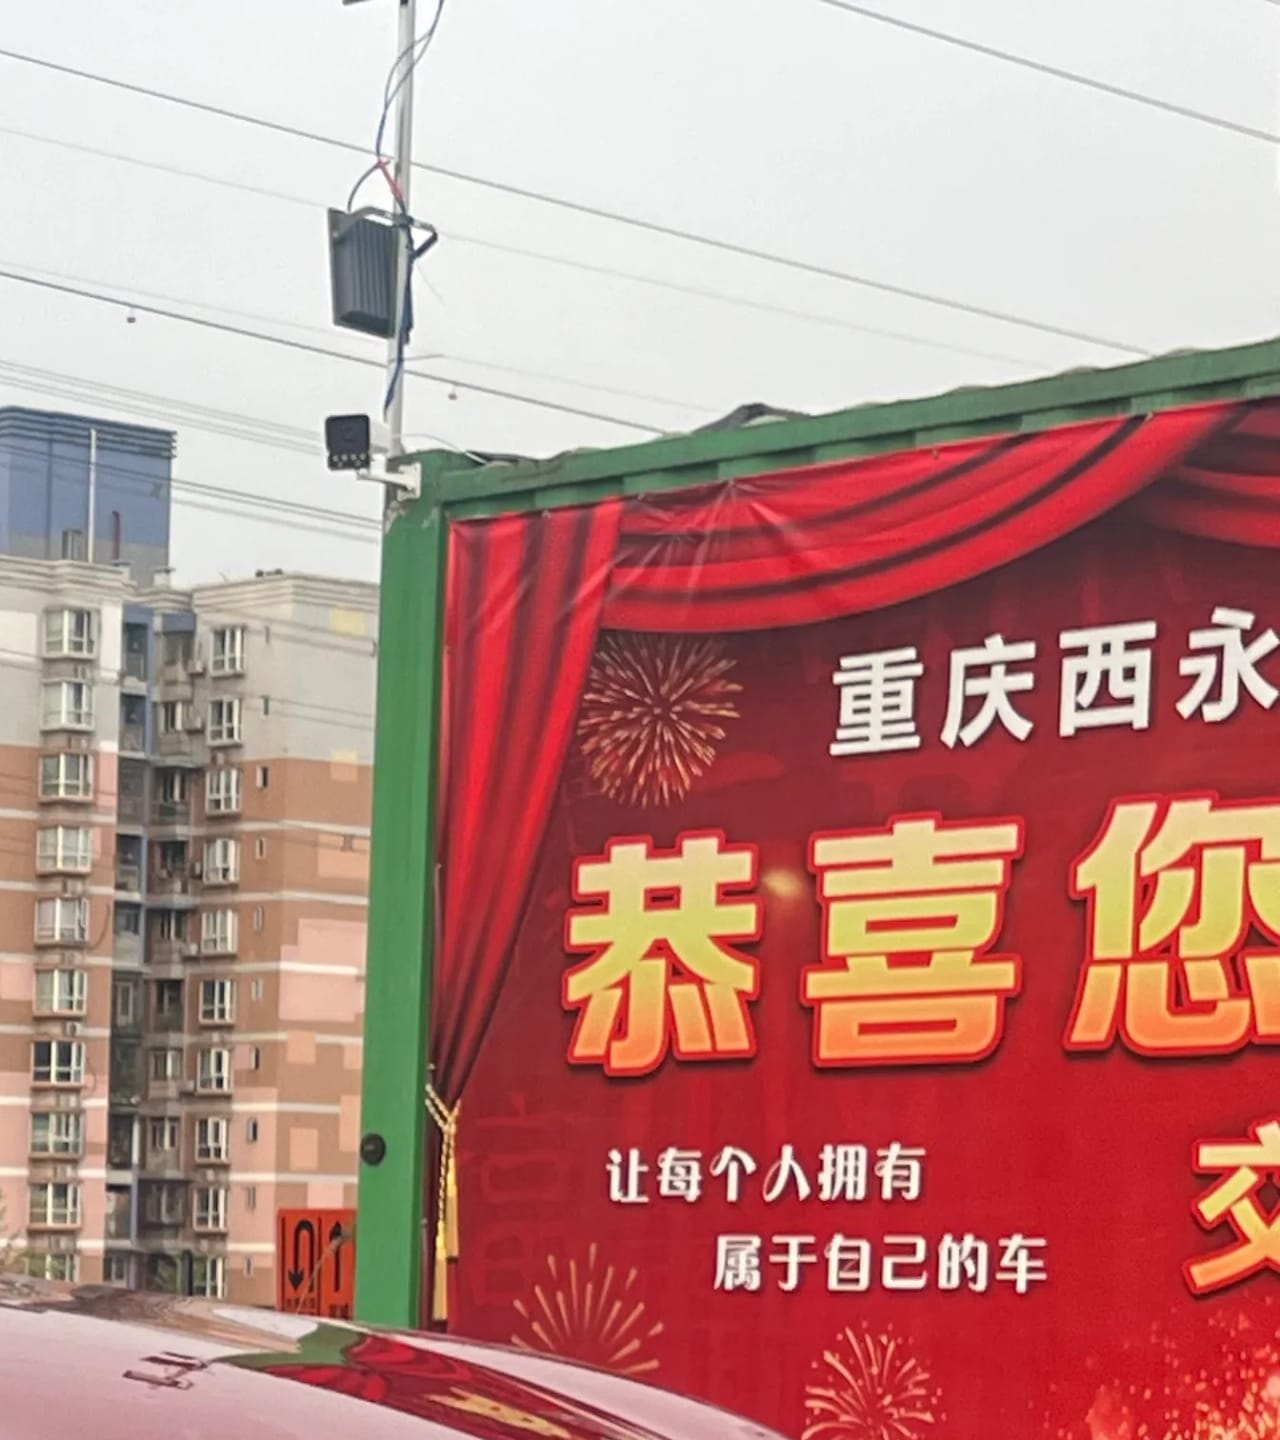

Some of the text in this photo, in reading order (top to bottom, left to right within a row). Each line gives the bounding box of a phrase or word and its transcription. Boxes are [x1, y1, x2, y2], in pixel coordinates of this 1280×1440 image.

[829, 606, 1280, 757] 重庆西永
[565, 796, 1280, 1072] 恭喜您
[605, 1141, 928, 1204] 让每个人拥有
[713, 1232, 1048, 1294] 属于自己的车
